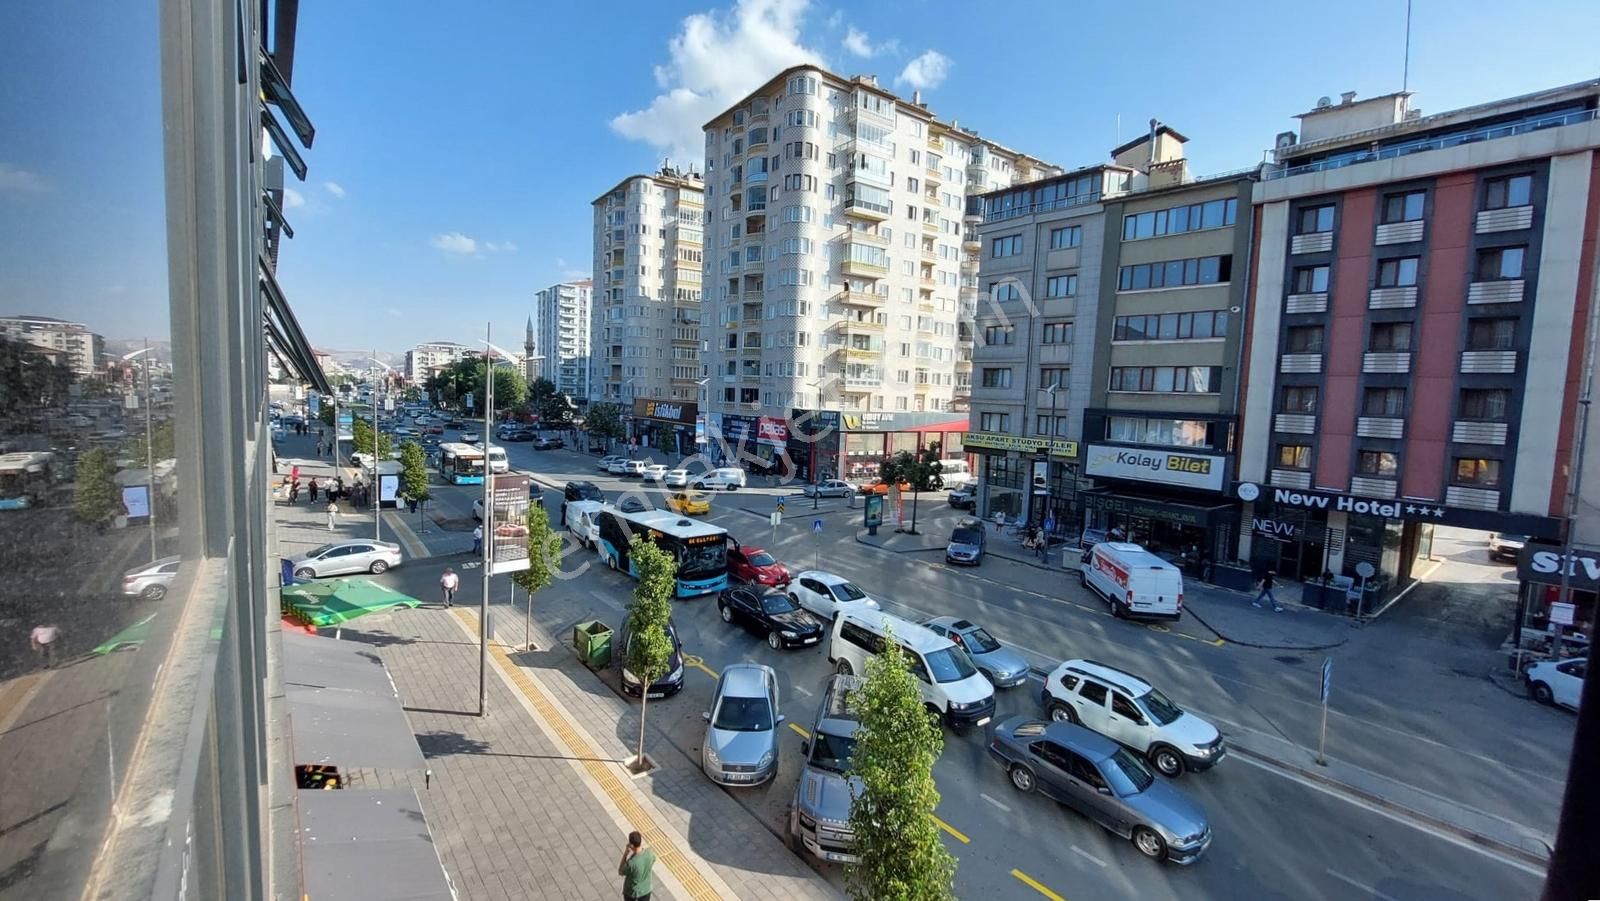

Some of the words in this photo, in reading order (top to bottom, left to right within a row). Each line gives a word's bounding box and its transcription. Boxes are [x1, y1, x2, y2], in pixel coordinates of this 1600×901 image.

[654, 402, 683, 419] istikbal
[966, 433, 985, 441] AKSU
[986, 435, 1009, 443] APART
[1045, 441, 1073, 449] EVLER
[1116, 452, 1162, 471] Kolay
[1168, 456, 1210, 474] Bilet
[1274, 489, 1329, 509] Nevv
[1337, 497, 1402, 518] Hotel
